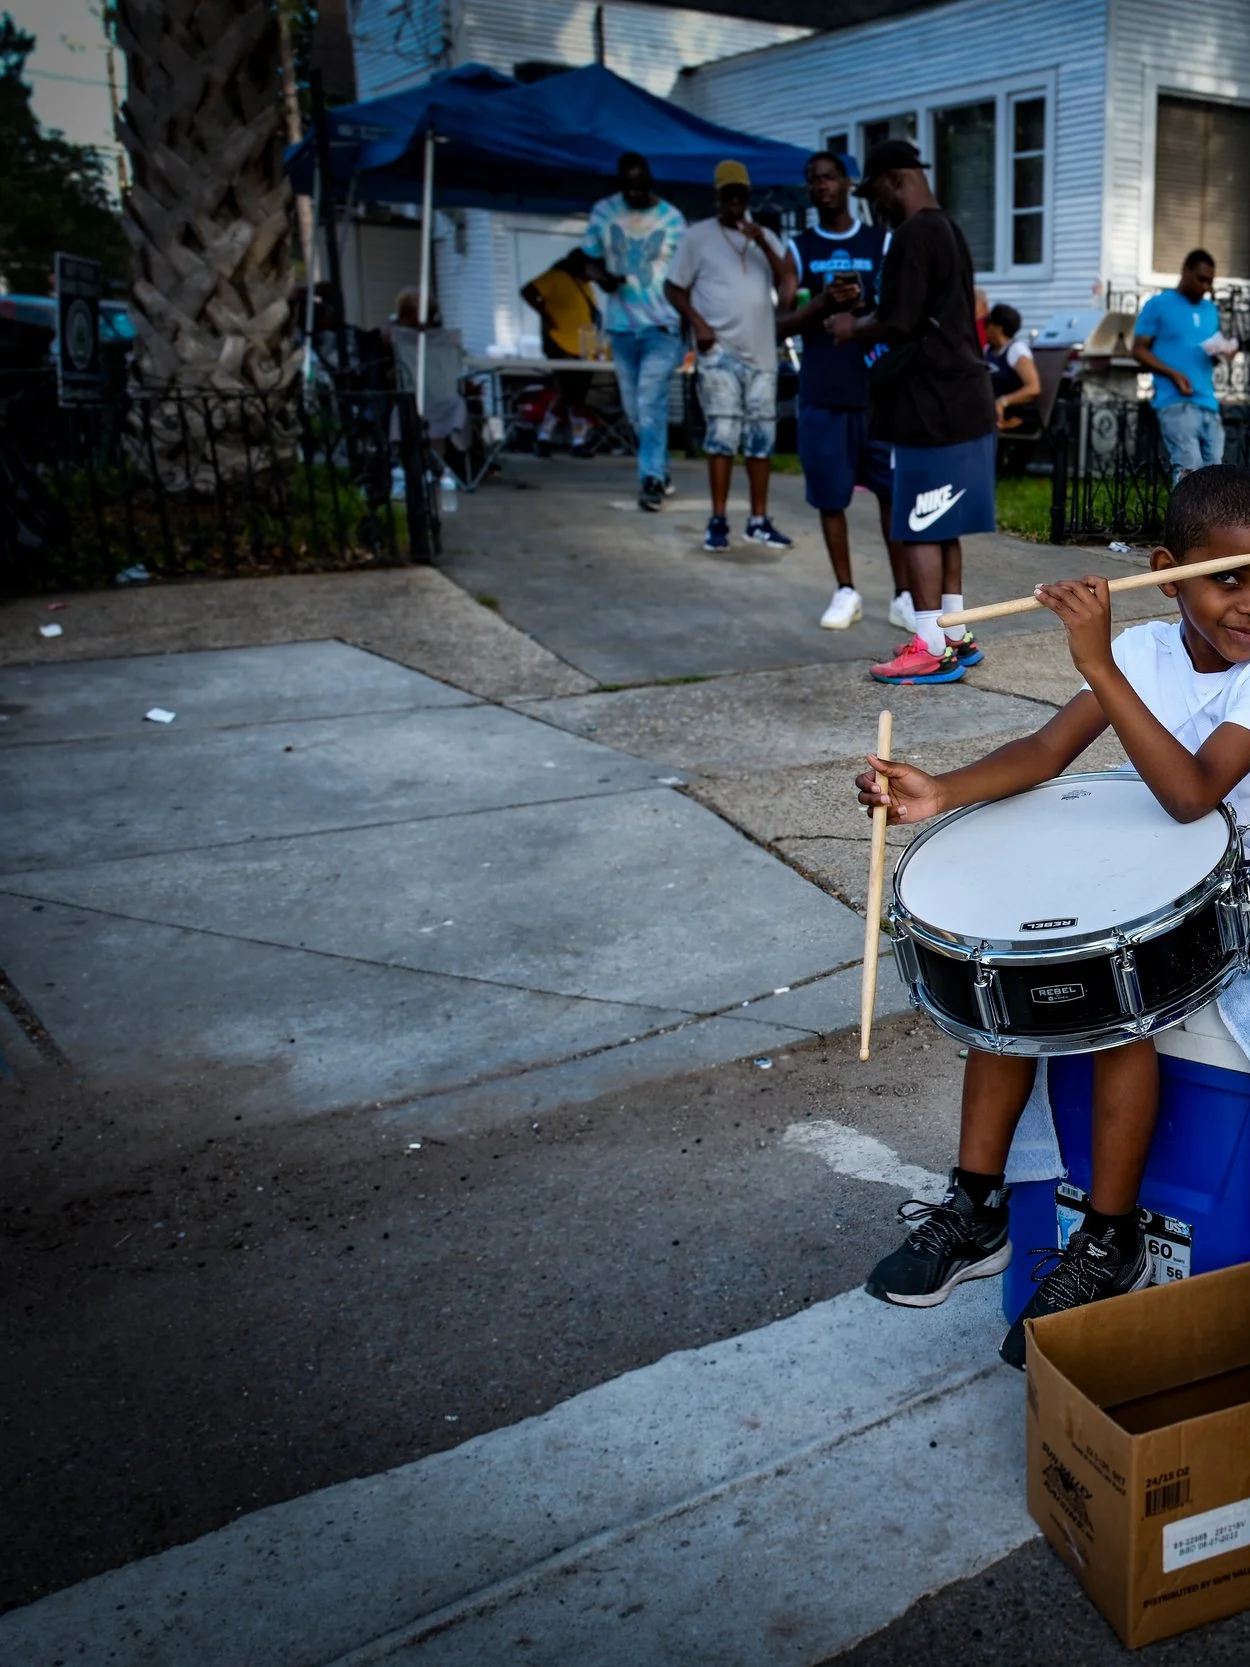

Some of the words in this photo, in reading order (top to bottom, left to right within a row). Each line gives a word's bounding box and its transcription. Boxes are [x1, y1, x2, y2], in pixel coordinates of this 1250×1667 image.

[915, 484, 953, 515] NIKE
[1027, 920, 1071, 929] REBEL
[1038, 986, 1077, 997] REBEL
[1088, 1242, 1108, 1256] Reebok
[1148, 1239, 1173, 1259] 60
[1166, 1266, 1183, 1279] 56
[1143, 1584, 1199, 1609] DISTRIBUTED
[1200, 1579, 1211, 1590] BY
[1212, 1574, 1231, 1586] SUN
